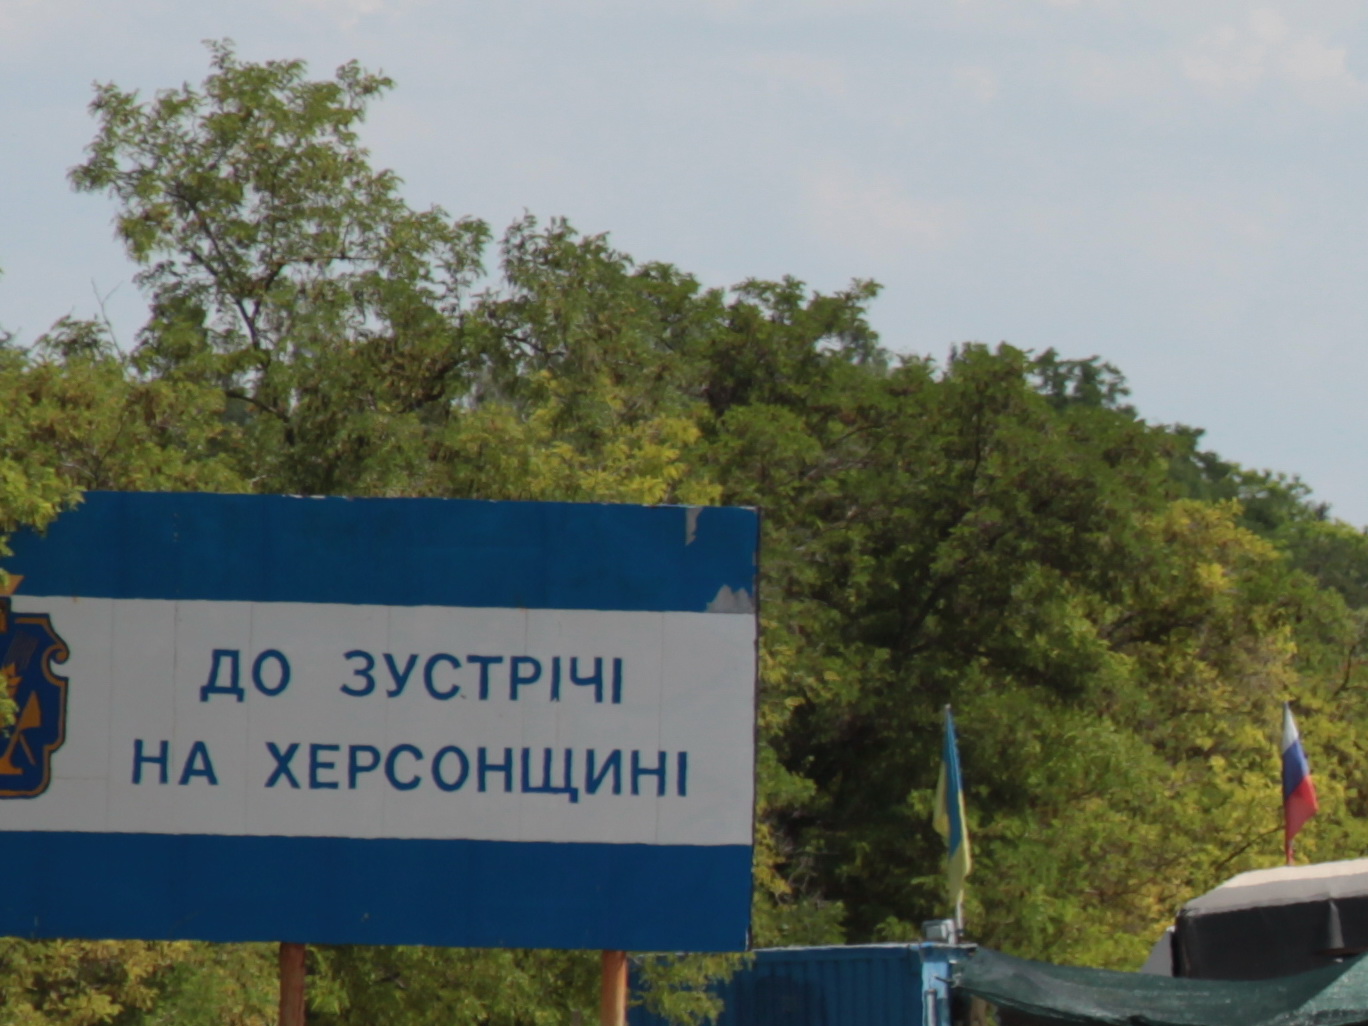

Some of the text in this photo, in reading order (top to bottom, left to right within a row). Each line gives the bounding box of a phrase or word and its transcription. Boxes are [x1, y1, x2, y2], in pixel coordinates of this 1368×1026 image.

[200, 649, 624, 704] ДО ЗУСТРІЧІ
[131, 739, 689, 804] НА ХЕРСОНЩИНІ
